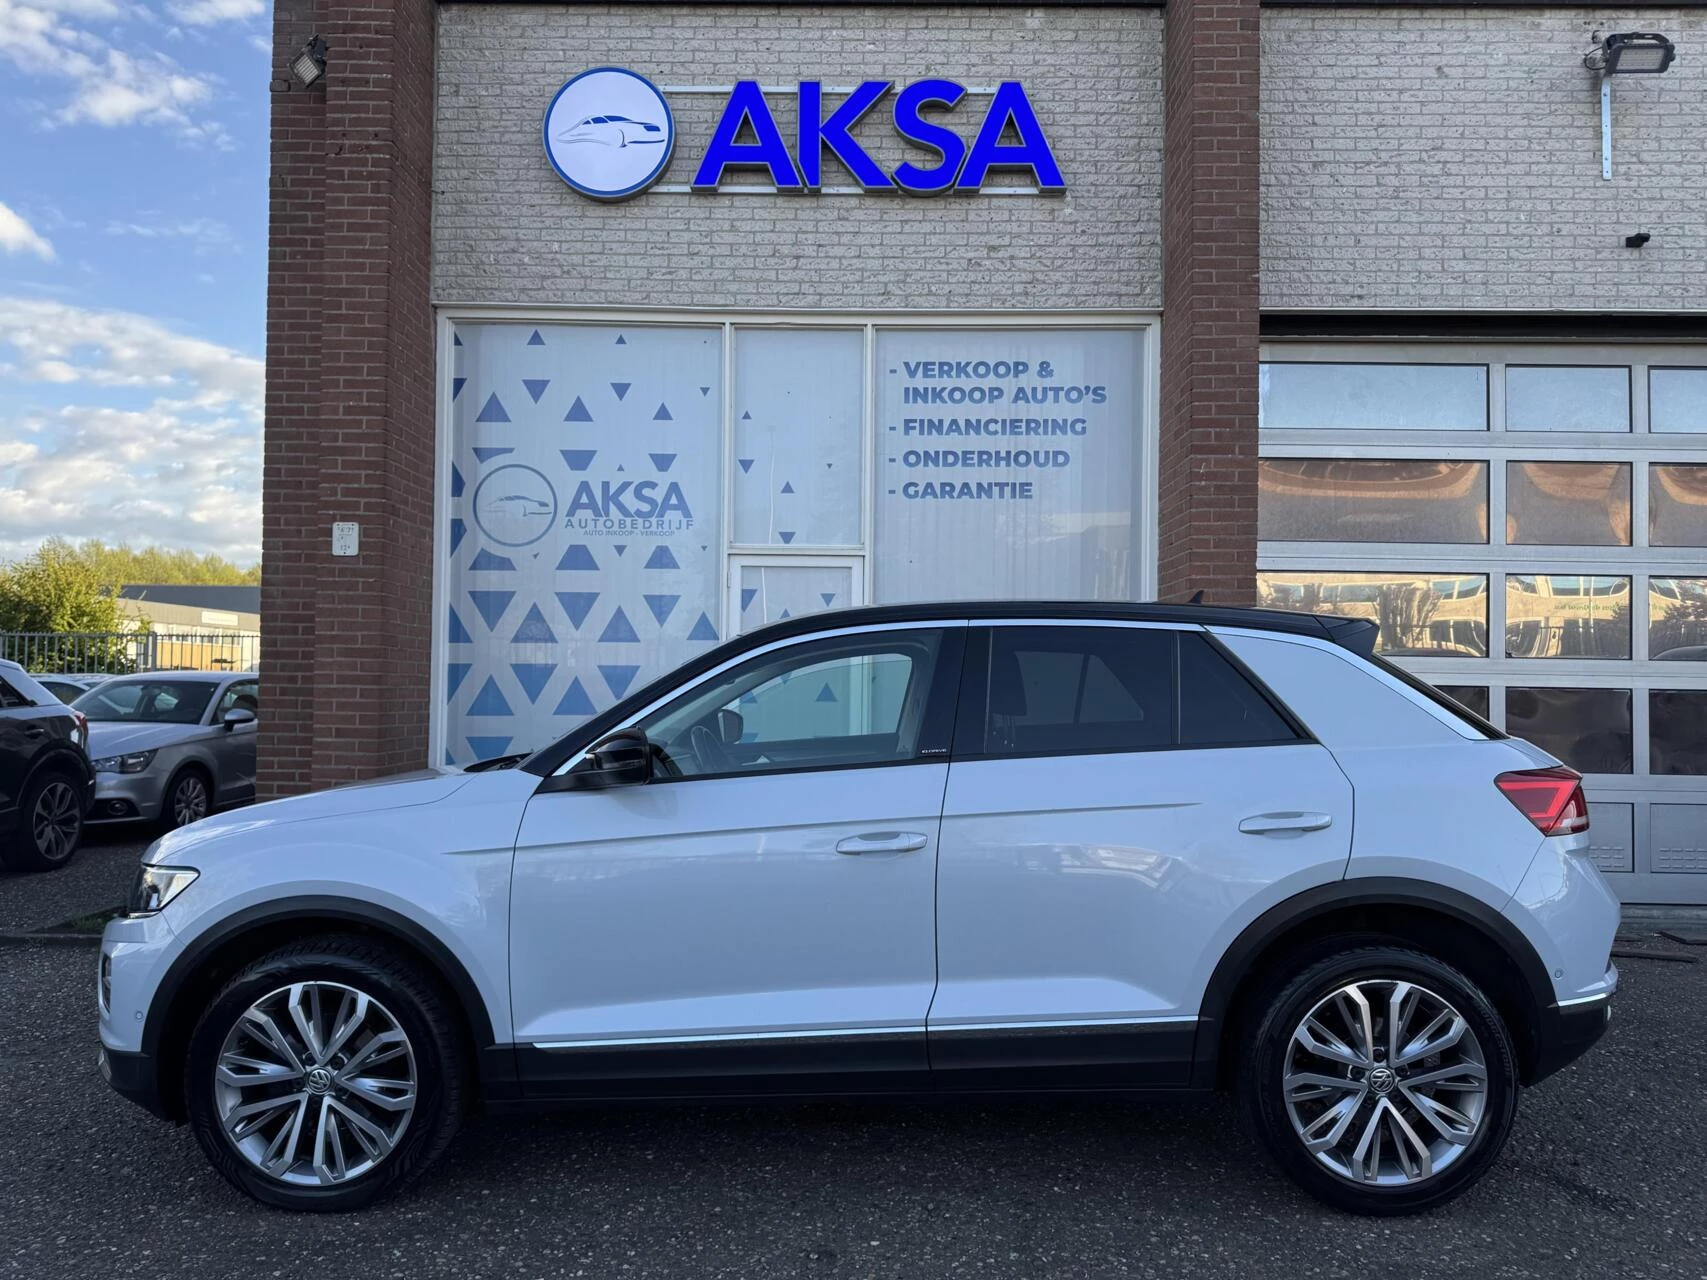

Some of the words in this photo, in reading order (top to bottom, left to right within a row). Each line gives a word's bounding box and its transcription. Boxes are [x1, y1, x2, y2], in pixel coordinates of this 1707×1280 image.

[690, 79, 1067, 196] AKSA
[903, 361, 1029, 379] VERKOOP
[1036, 360, 1054, 379] &
[903, 386, 1005, 404] INKOOP
[1012, 385, 1107, 404] AUTO’S
[903, 418, 1087, 436] FINANCIERING
[903, 450, 1071, 468] ONDERHOUD
[565, 480, 693, 519] AKSA
[902, 482, 1033, 499] GARANTIE
[564, 518, 694, 530] AUTOBEDRIJF
